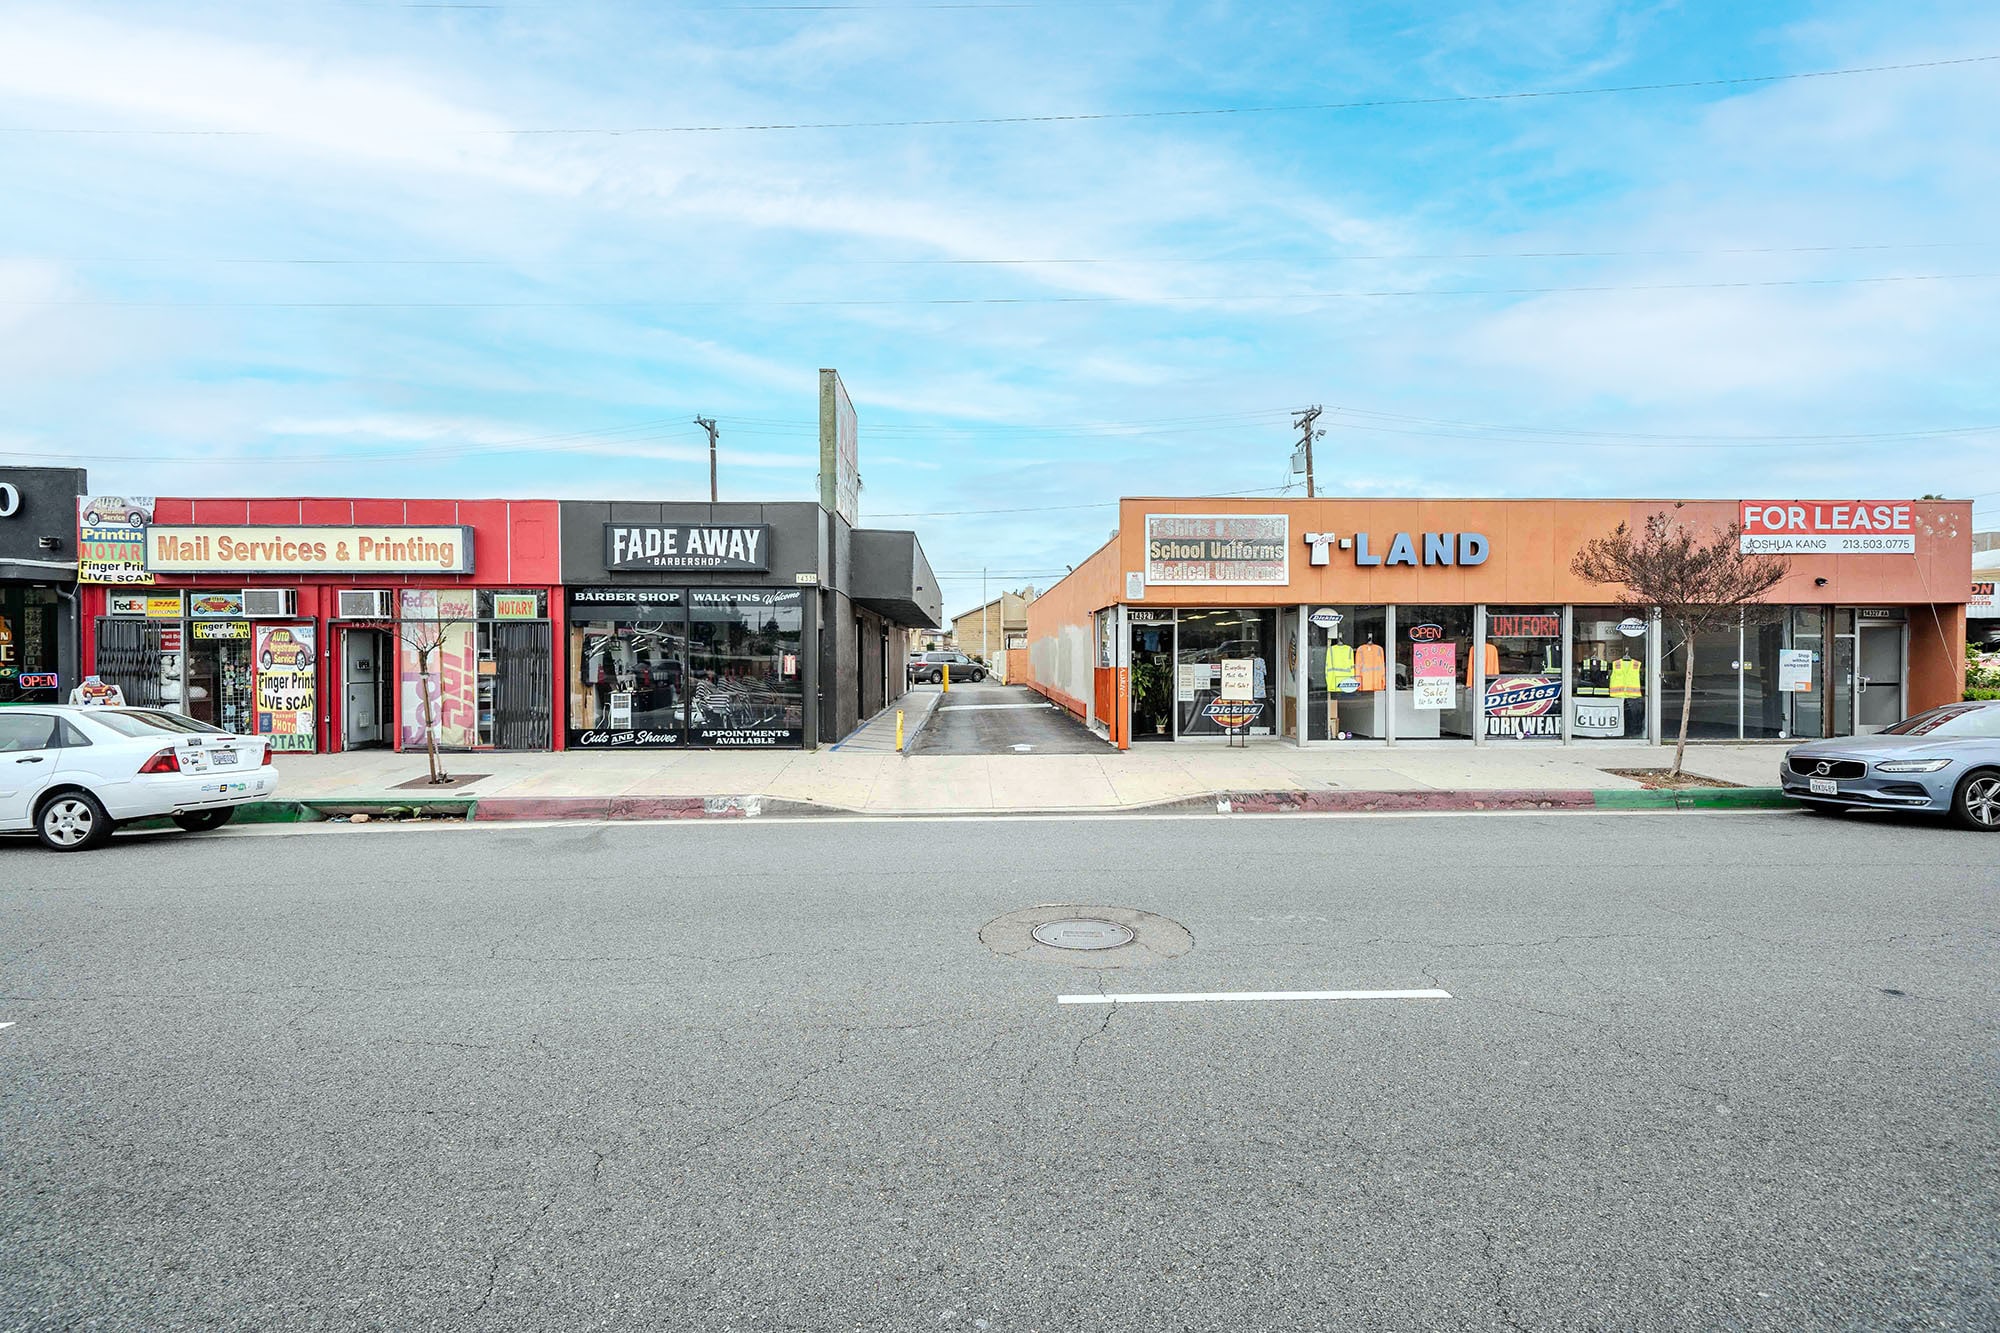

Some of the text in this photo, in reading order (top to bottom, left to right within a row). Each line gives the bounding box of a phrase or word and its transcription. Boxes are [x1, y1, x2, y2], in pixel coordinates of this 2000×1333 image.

[1744, 506, 1910, 530] FOR LEASE
[81, 528, 144, 542] Printin
[81, 543, 144, 560] NOTAR
[157, 535, 454, 568] Mail Services & Printing
[613, 528, 761, 564] FADE AWAY
[1151, 540, 1285, 560] School Uniforms
[1745, 539, 1910, 550] JOSHUA KANG 213.503.0775
[80, 560, 121, 573] Finger
[653, 557, 721, 567] BARBERSHOP
[80, 572, 153, 583] LIVE SCAN
[401, 591, 437, 608] FedEx
[574, 592, 680, 602] BARBER SHOP
[692, 591, 801, 605] WALK-INS Welcome
[113, 600, 144, 611] FedEx
[497, 600, 533, 615] NOTARY
[194, 622, 249, 631] Finger Print
[1410, 626, 1441, 639] OPEN
[1493, 616, 1560, 637] UNIFORM
[221, 630, 250, 638] SCAN
[272, 631, 290, 641] AUTO
[273, 654, 296, 664] Service
[1415, 646, 1453, 660] STORE
[1414, 658, 1454, 675] CLOSING
[22, 676, 55, 687] OPEN
[259, 672, 314, 693] Finger Print
[259, 691, 283, 711] LIVE
[1487, 687, 1556, 707] Dickies
[1209, 706, 1257, 714] Dickies
[272, 720, 297, 734] PHOTO
[1485, 717, 1561, 735] ORKWEAR
[1577, 715, 1617, 727] CLUB
[581, 731, 678, 744] Cuts AND Shaves
[701, 730, 790, 738] APPOINTMENTS
[715, 737, 776, 745] AVAILABLE
[268, 735, 314, 750] OTARY
